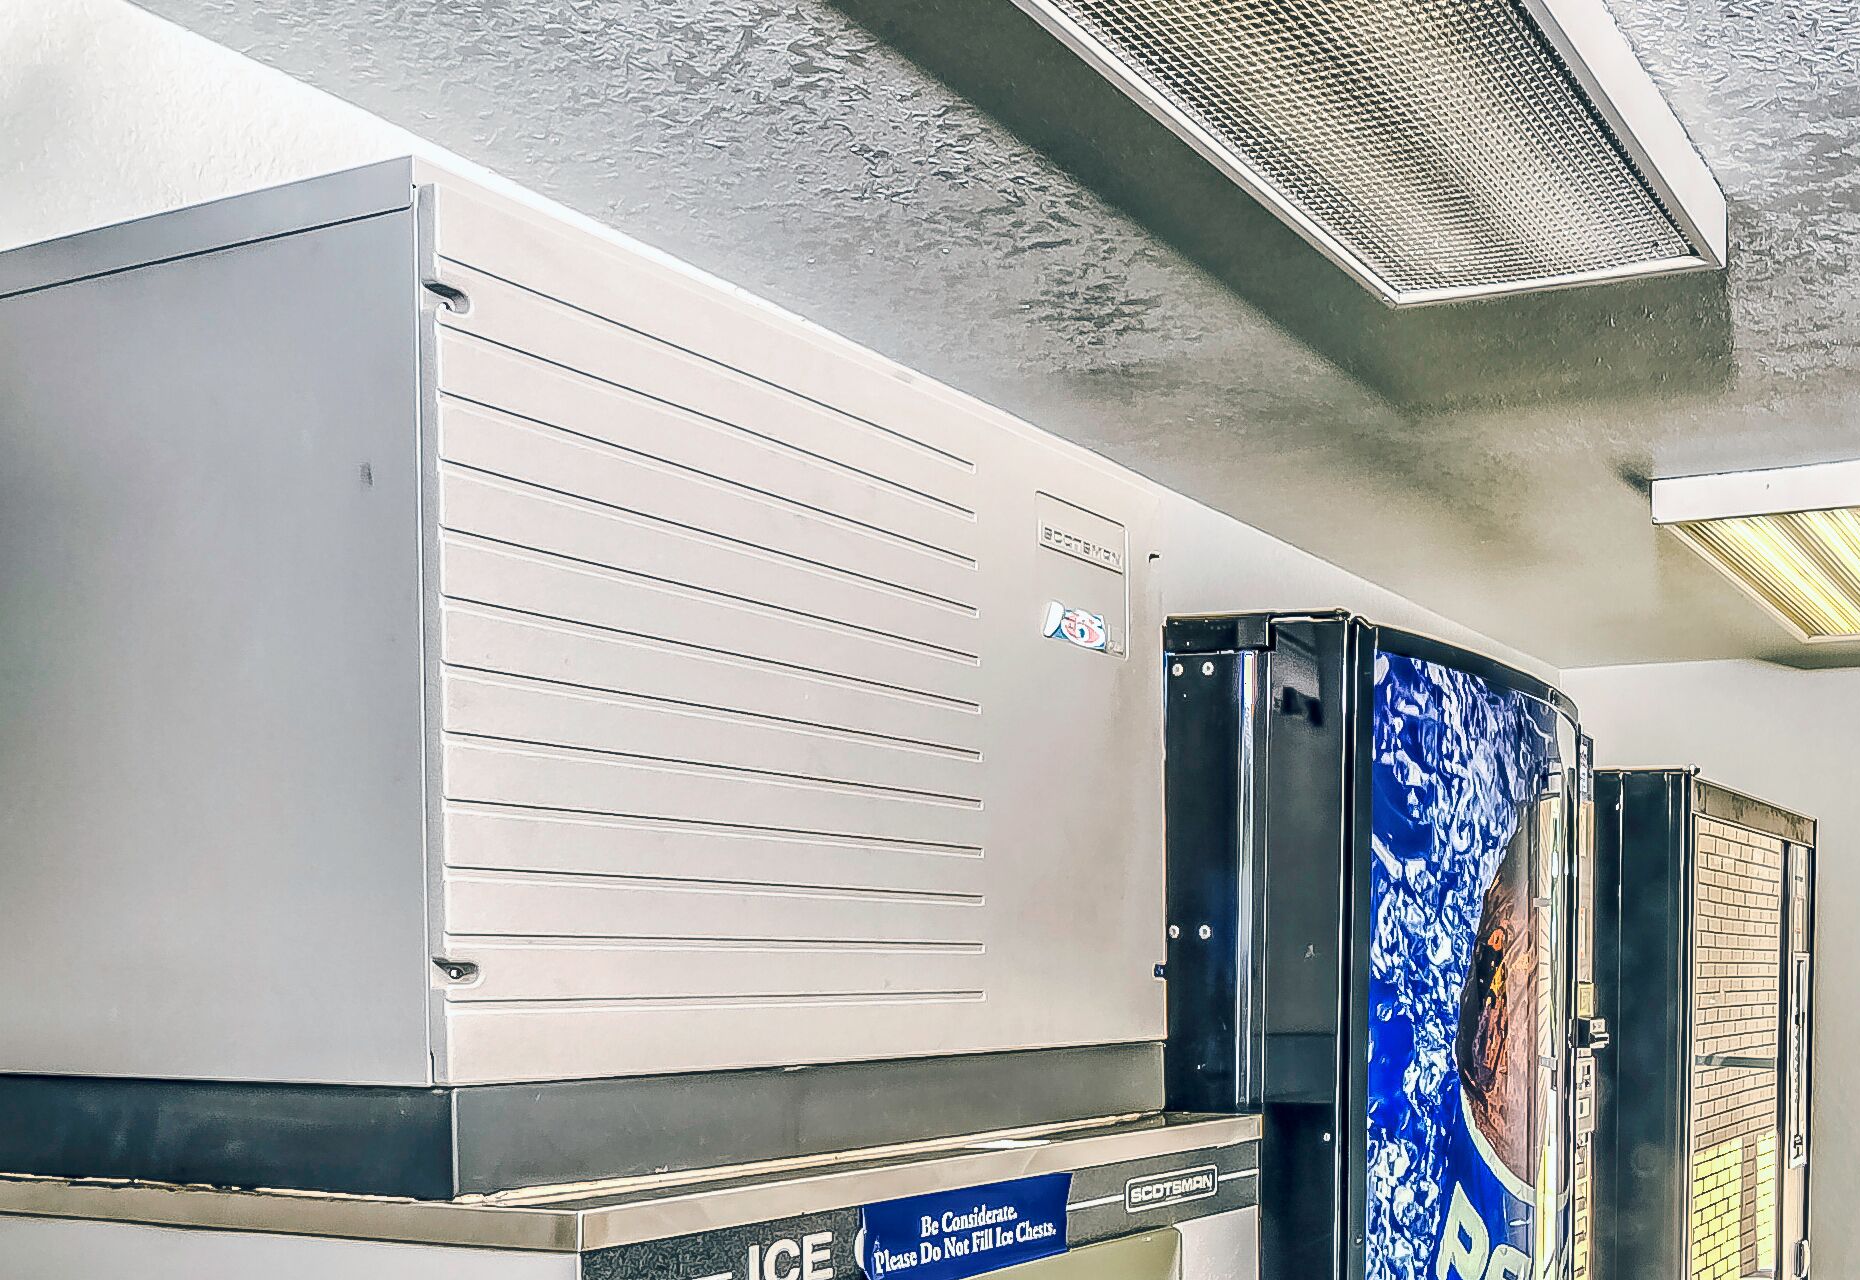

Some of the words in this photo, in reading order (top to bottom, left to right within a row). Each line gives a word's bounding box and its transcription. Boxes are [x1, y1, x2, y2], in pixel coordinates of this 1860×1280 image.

[1130, 1173, 1213, 1203] SCOTSMAN
[920, 1215, 939, 1238] Be
[941, 1203, 1018, 1232] Considerate.
[874, 1248, 918, 1275] Please
[920, 1242, 941, 1265] Do
[944, 1236, 970, 1260] Not
[971, 1228, 994, 1253] Fill
[996, 1226, 1014, 1248] Ice
[1015, 1220, 1057, 1242] Chests.
